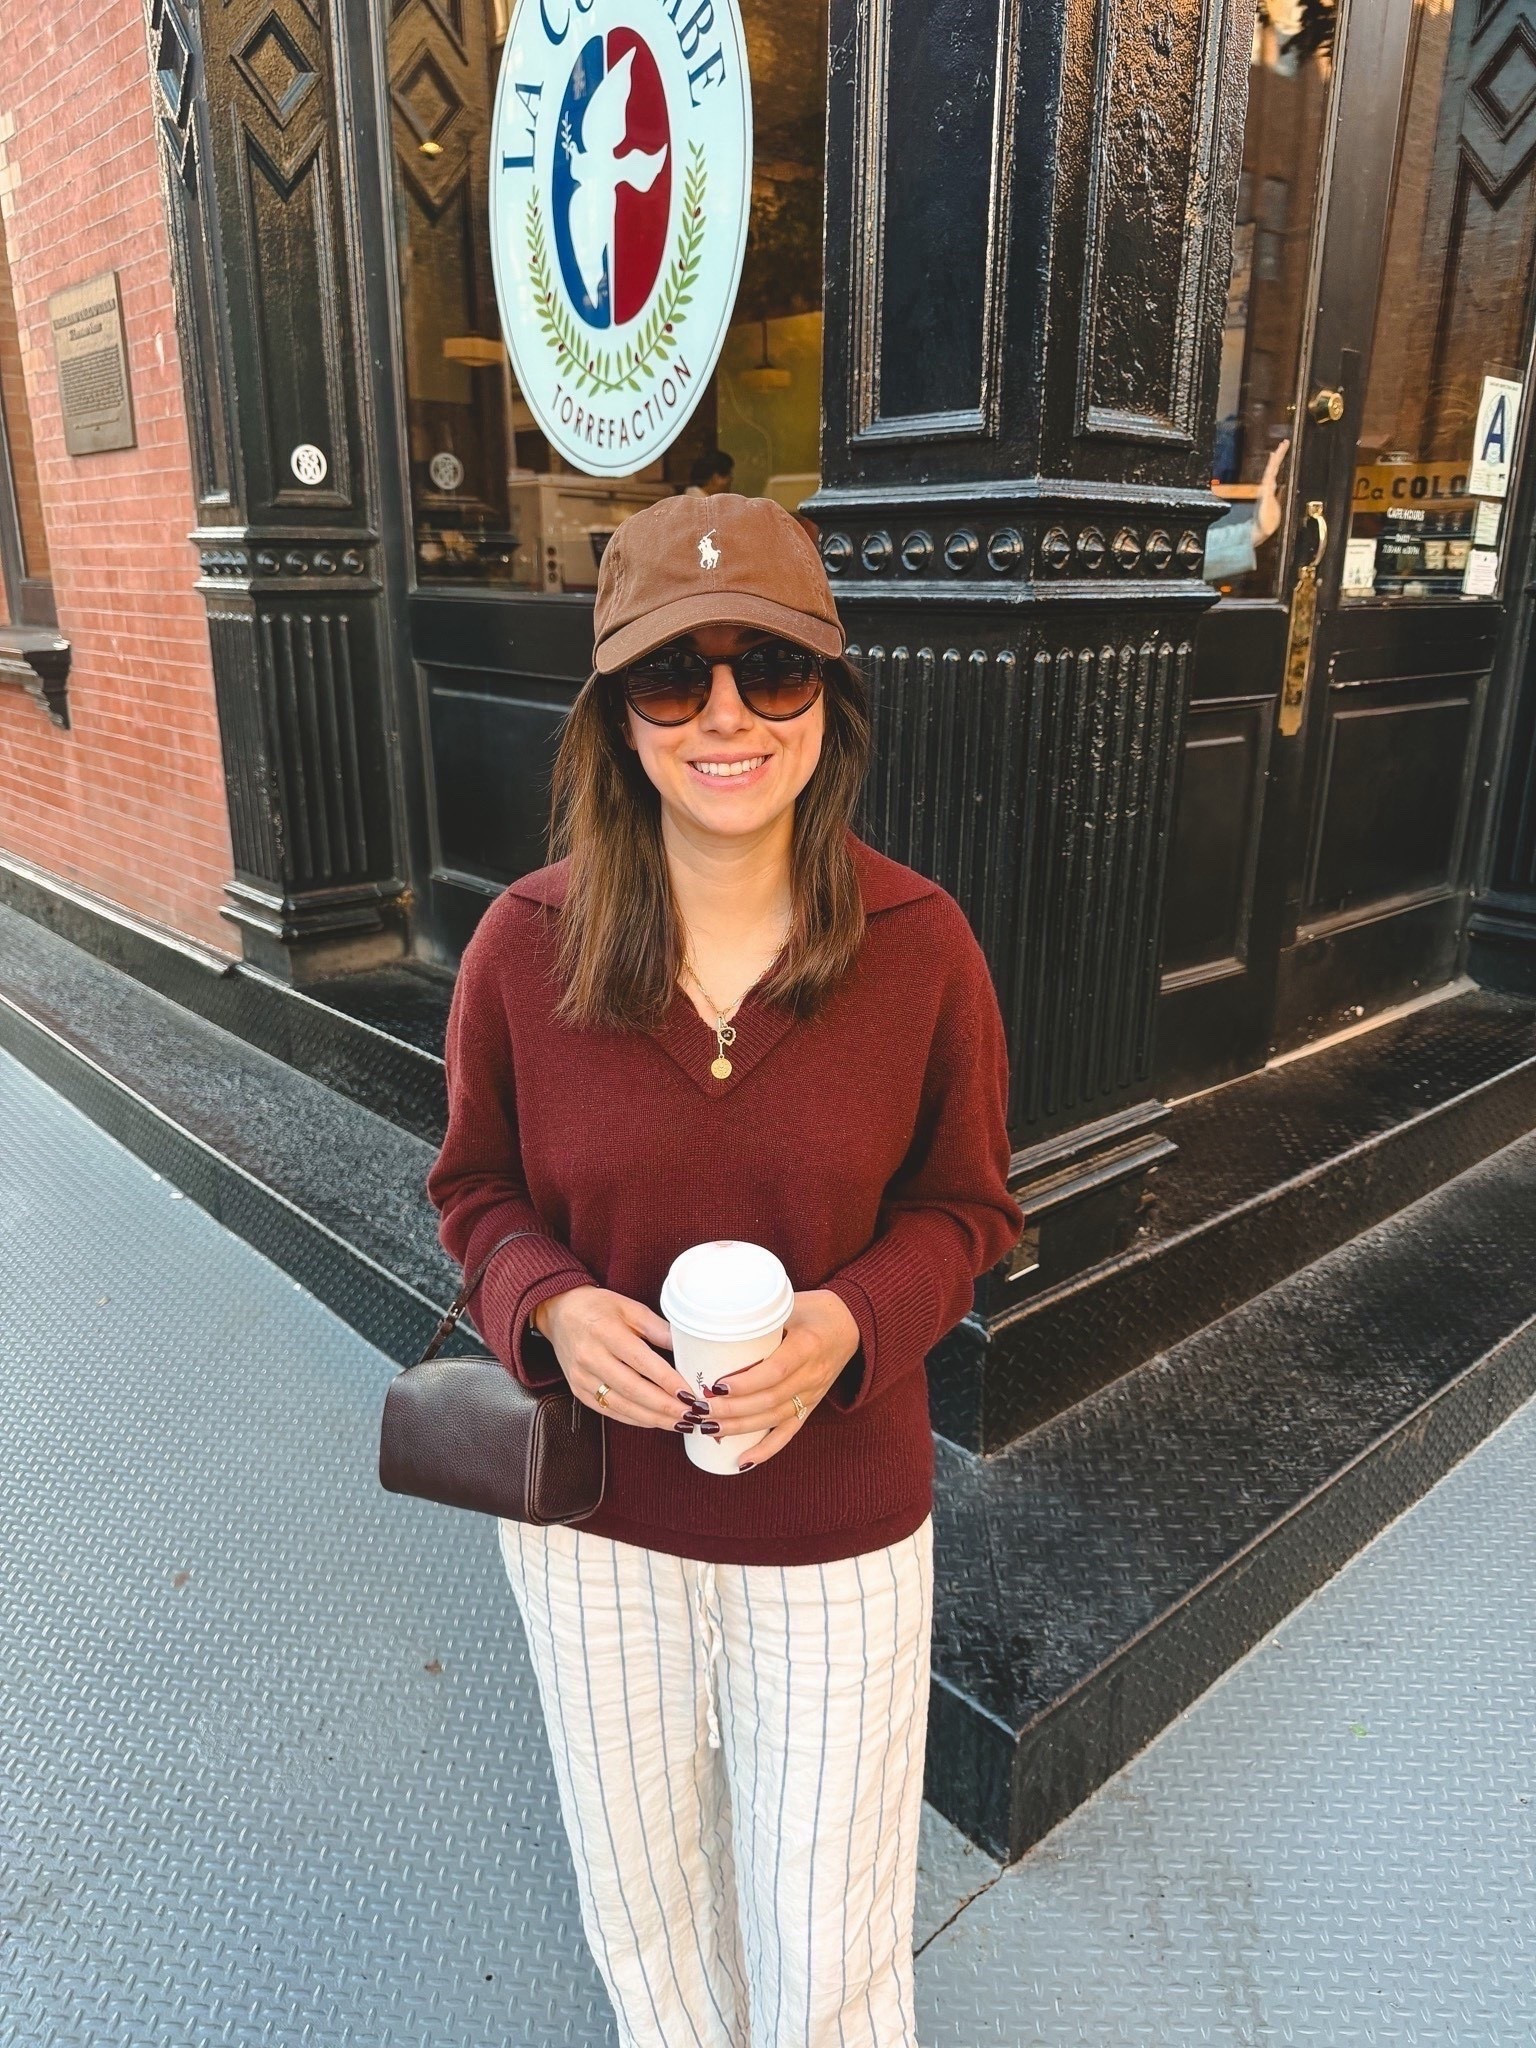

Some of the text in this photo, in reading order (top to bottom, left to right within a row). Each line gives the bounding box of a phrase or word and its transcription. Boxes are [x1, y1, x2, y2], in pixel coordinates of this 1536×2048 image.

[502, 80, 544, 174] LA
[552, 354, 692, 450] TORREFACTION
[1481, 395, 1506, 463] A
